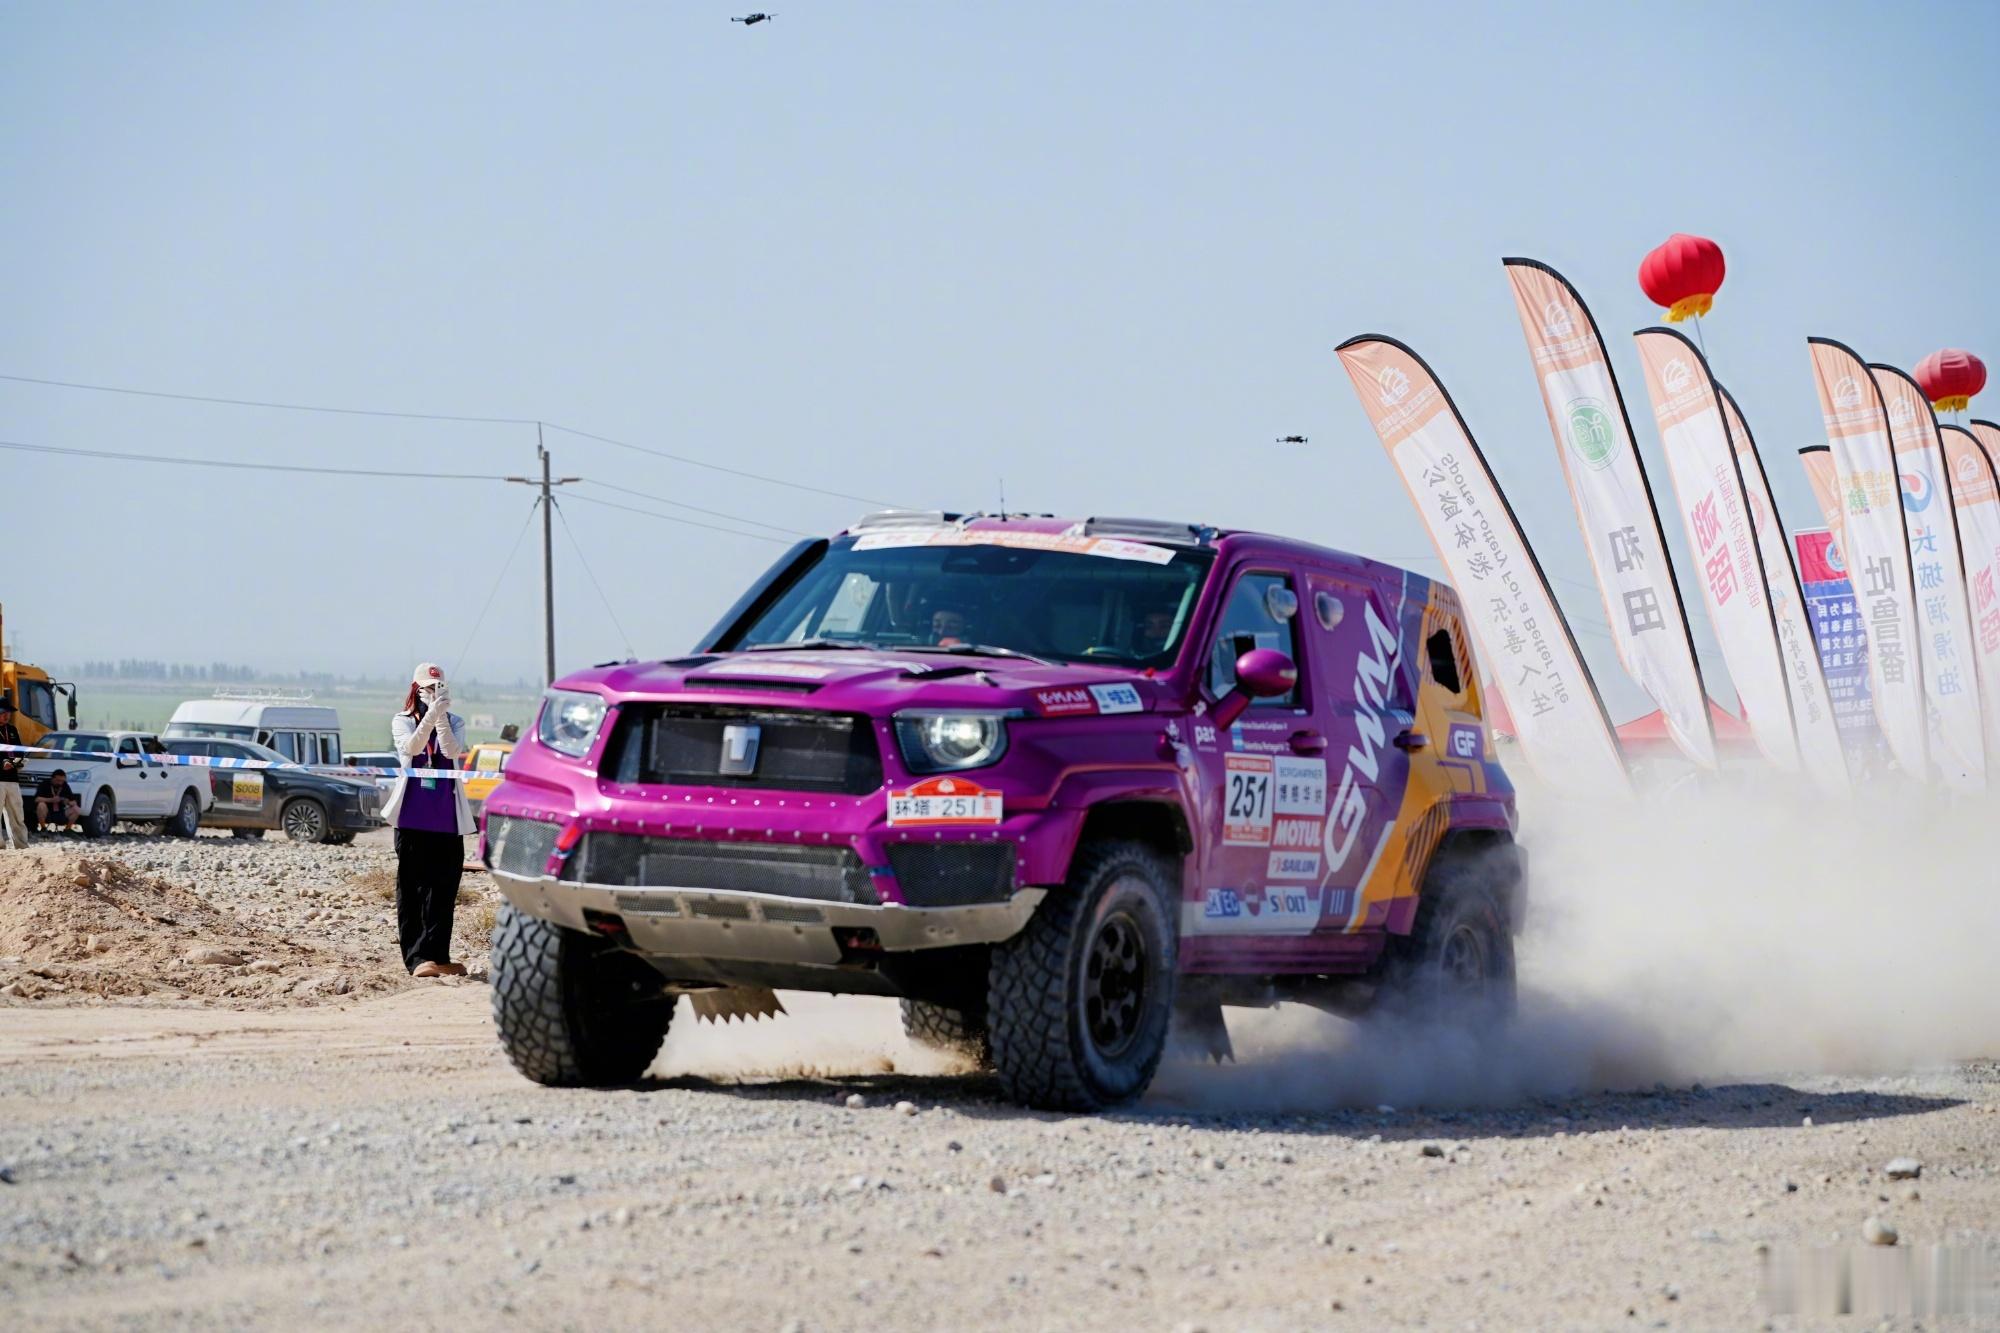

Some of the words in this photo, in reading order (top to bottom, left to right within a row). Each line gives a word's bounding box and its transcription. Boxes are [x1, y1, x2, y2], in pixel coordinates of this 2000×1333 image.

[1324, 601, 1397, 873] GWM
[1453, 730, 1476, 757] GF
[235, 783, 260, 795] S008
[1229, 774, 1269, 819] 251
[895, 799, 931, 817] 环塔
[941, 799, 977, 817] 251
[1273, 819, 1322, 847] MOTUL
[1280, 858, 1317, 874] SAILUN
[1270, 892, 1306, 914] SVOLT
